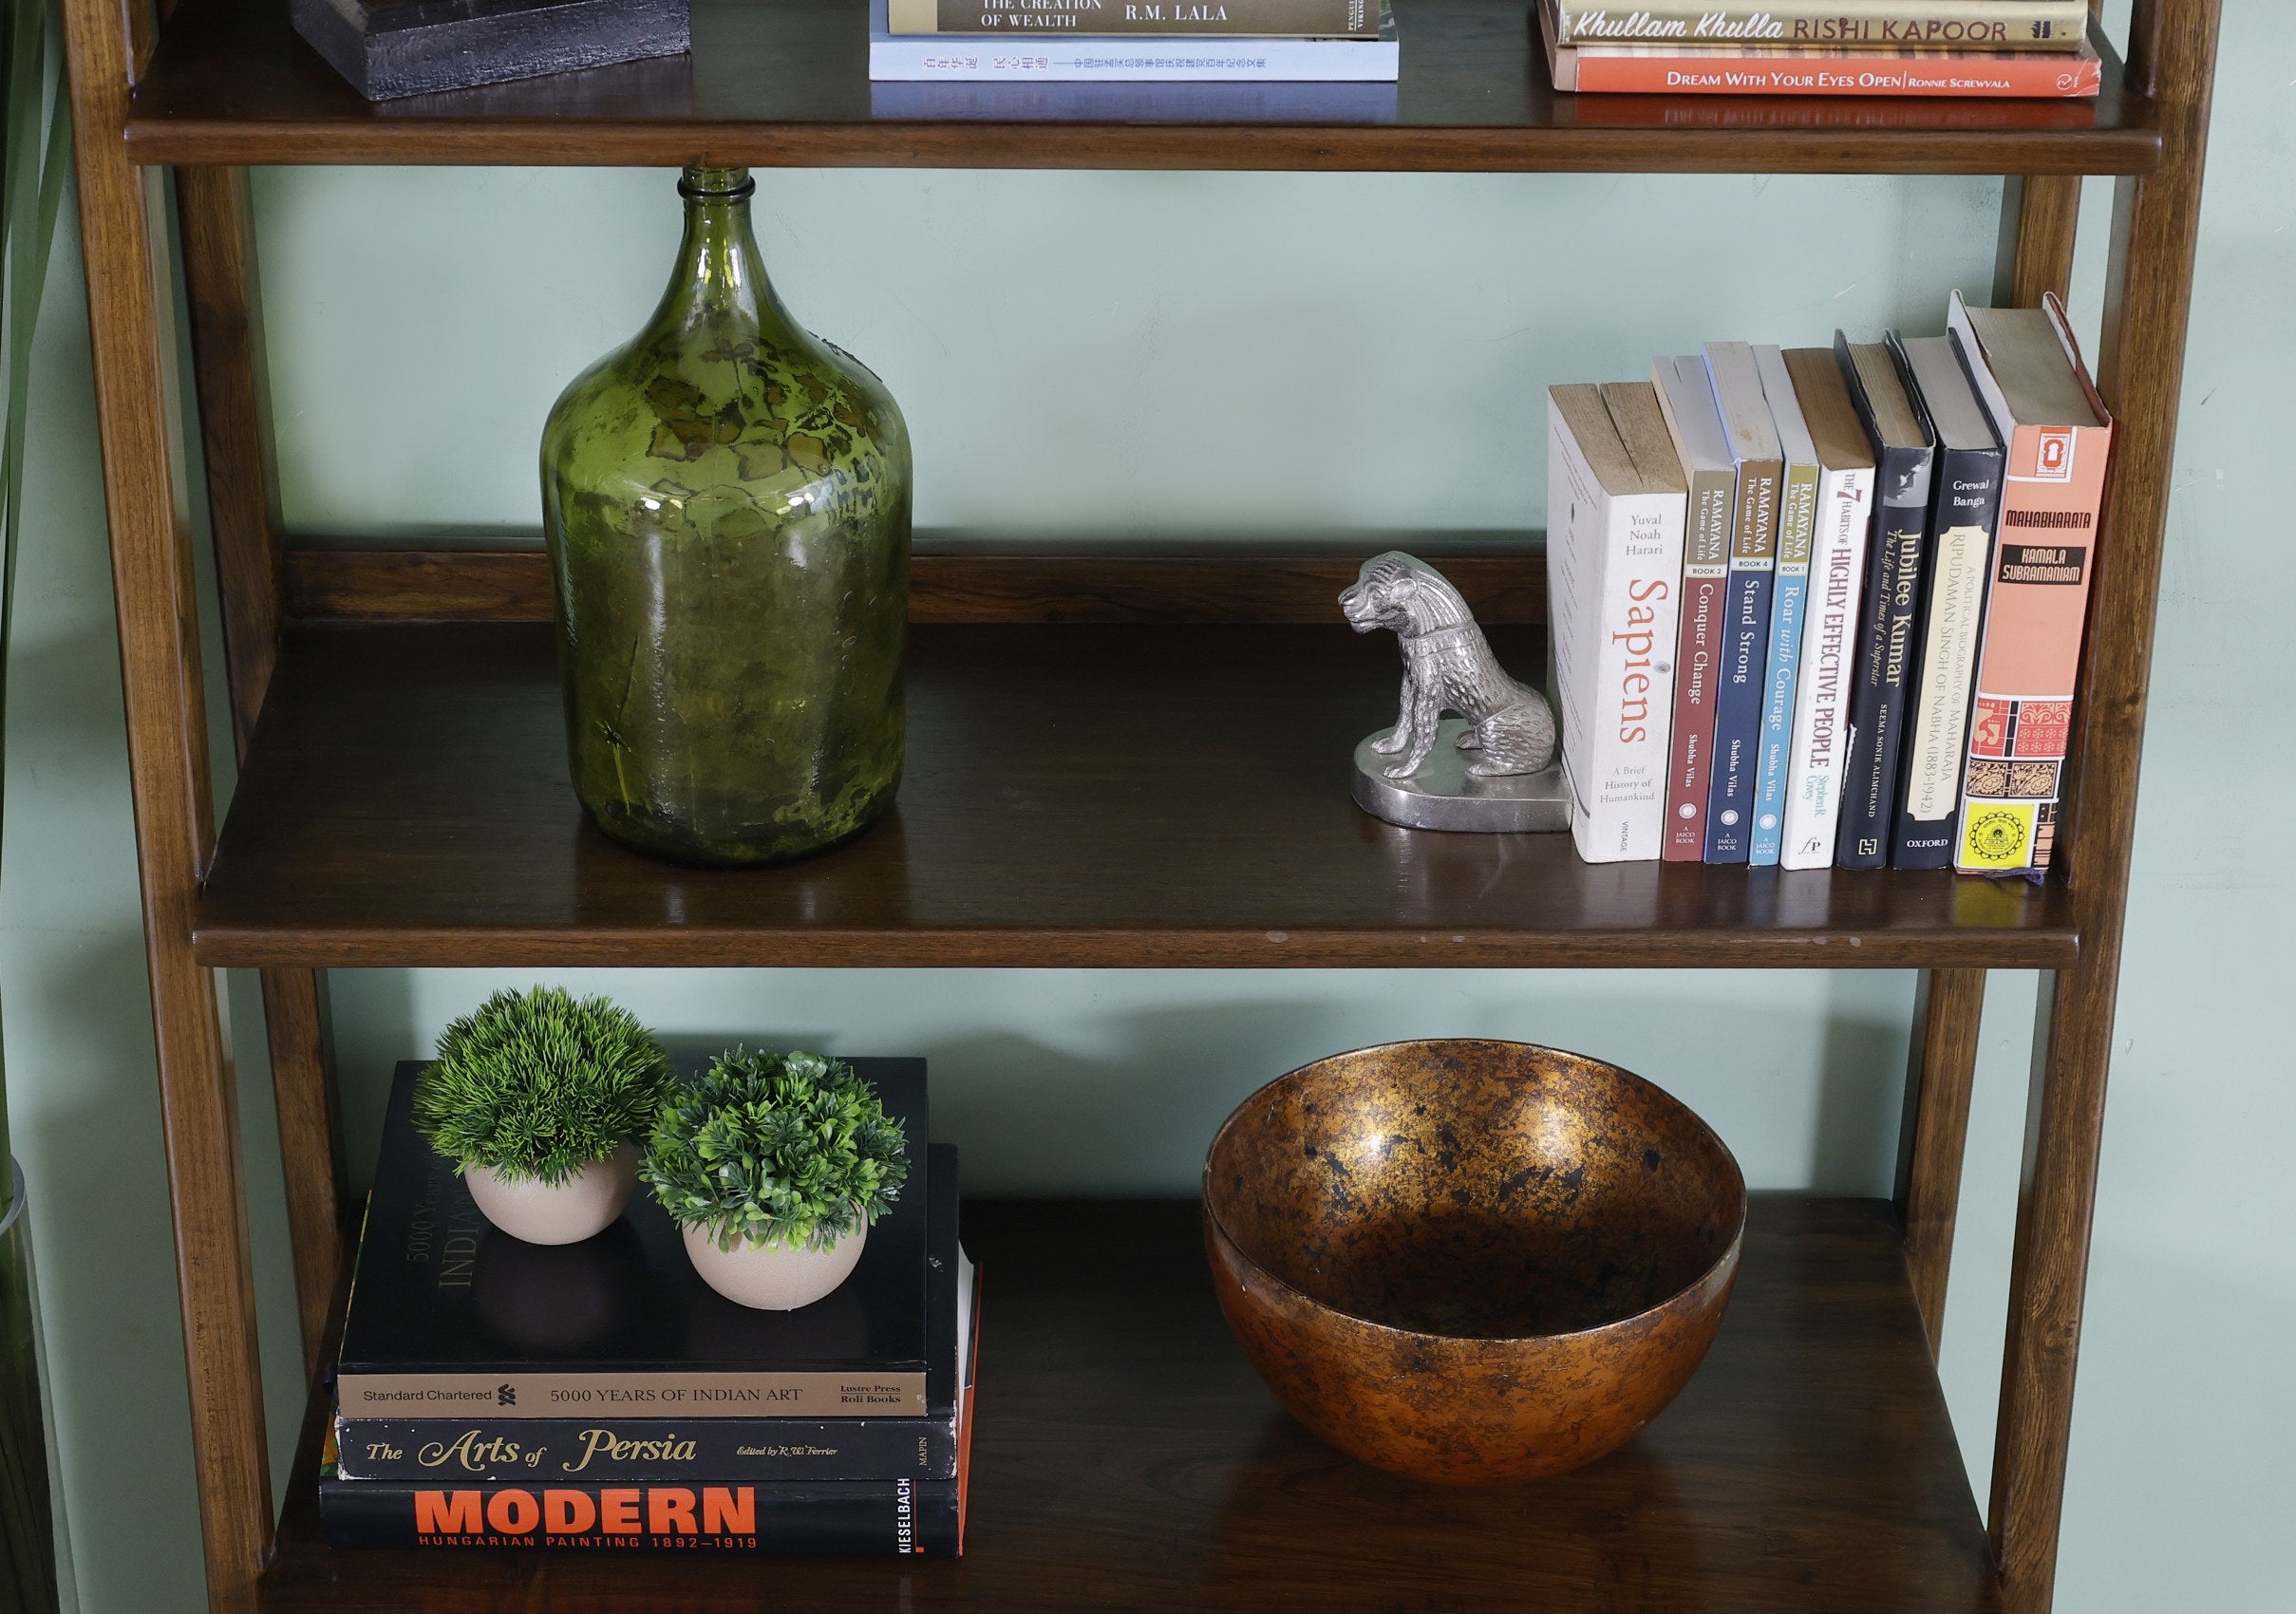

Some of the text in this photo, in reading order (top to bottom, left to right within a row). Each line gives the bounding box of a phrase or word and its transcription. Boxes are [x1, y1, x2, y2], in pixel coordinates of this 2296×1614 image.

[984, 0, 1101, 9] THE CREATION
[1124, 4, 1228, 20] R.M. LALA
[981, 14, 1076, 27] OF WEALTH
[1573, 9, 1783, 38] Khullam Khulla
[1794, 18, 2007, 42] RISHI KAPOOR
[1666, 71, 1901, 87] DREAM WITH YOUR EYES OPEN
[1908, 77, 2010, 88] RONNIE SCREWVALA
[1952, 479, 1990, 491] Grewal
[1742, 478, 1757, 554] The Game of Life
[1754, 478, 1773, 554] RAMAYANA
[1952, 496, 1985, 508] Banga
[1631, 514, 1662, 525] Yuval
[1697, 490, 1710, 561] The Game of Life
[1708, 490, 1724, 560] RAMAYANA
[1783, 483, 1799, 559] The Game of Life
[1794, 483, 1813, 558] RAMAYANA
[2005, 510, 2092, 529] MAHABHARATA
[1629, 529, 1661, 540] Noah
[1886, 530, 1898, 549] The
[1626, 544, 1663, 555] Harari
[1881, 551, 1895, 571] Life
[2021, 548, 2067, 564] KAMALA
[1881, 572, 1891, 591] and
[2002, 564, 2080, 582] SUBRAMANIAM
[1877, 593, 1891, 622] Times
[1886, 529, 1922, 687] Jubilee Kumar
[1960, 576, 1975, 629] POLITICAL
[1733, 580, 1760, 684] Stand Strong
[1810, 473, 1863, 768] THE 7 HABITS OF HIGHLY EFFECTIVE PEOPLE
[1873, 623, 1886, 635] of
[1687, 583, 1714, 704] Conquer Change
[1612, 579, 1668, 743] Sapiens
[1769, 586, 1799, 731] Roar with Courage
[1870, 643, 1885, 686] Superstar
[1952, 631, 1968, 690] BIOGRAPHY
[1919, 534, 1967, 814] RIPUDAMAN SINGH OF NABHA (1883-1942)
[1951, 692, 1961, 704] OF
[1941, 709, 1961, 780] MAHARAJA
[1613, 765, 1647, 776] A Brief
[1685, 734, 1698, 788] Shubha Vilas
[1726, 740, 1741, 798] Shubha Vilas
[1765, 743, 1779, 801] Shubha Vilas
[1868, 704, 1888, 817] SEEMA SONIK ALIMCHAND
[1600, 793, 1654, 803] Humankind
[1605, 779, 1653, 790] History of
[1802, 775, 1817, 801] Covey
[1815, 775, 1830, 810] Stephen
[1620, 821, 1628, 852] VINTAGE
[1907, 838, 1948, 848] OXFORD
[364, 1390, 492, 1401] Standard Chartered
[550, 1389, 802, 1402] 5000 YEARS OF INDIAN ART
[366, 1429, 697, 1473] The Arts of Persia
[736, 1445, 767, 1455] Edited
[767, 1446, 779, 1456] by
[804, 1444, 838, 1455] Ferrier
[918, 1436, 928, 1466] MAPIN
[413, 1487, 757, 1534] MODERN
[897, 1478, 912, 1553] KIESELBACH
[419, 1536, 536, 1547] HUNGARIAN
[546, 1536, 640, 1548] PAINTING
